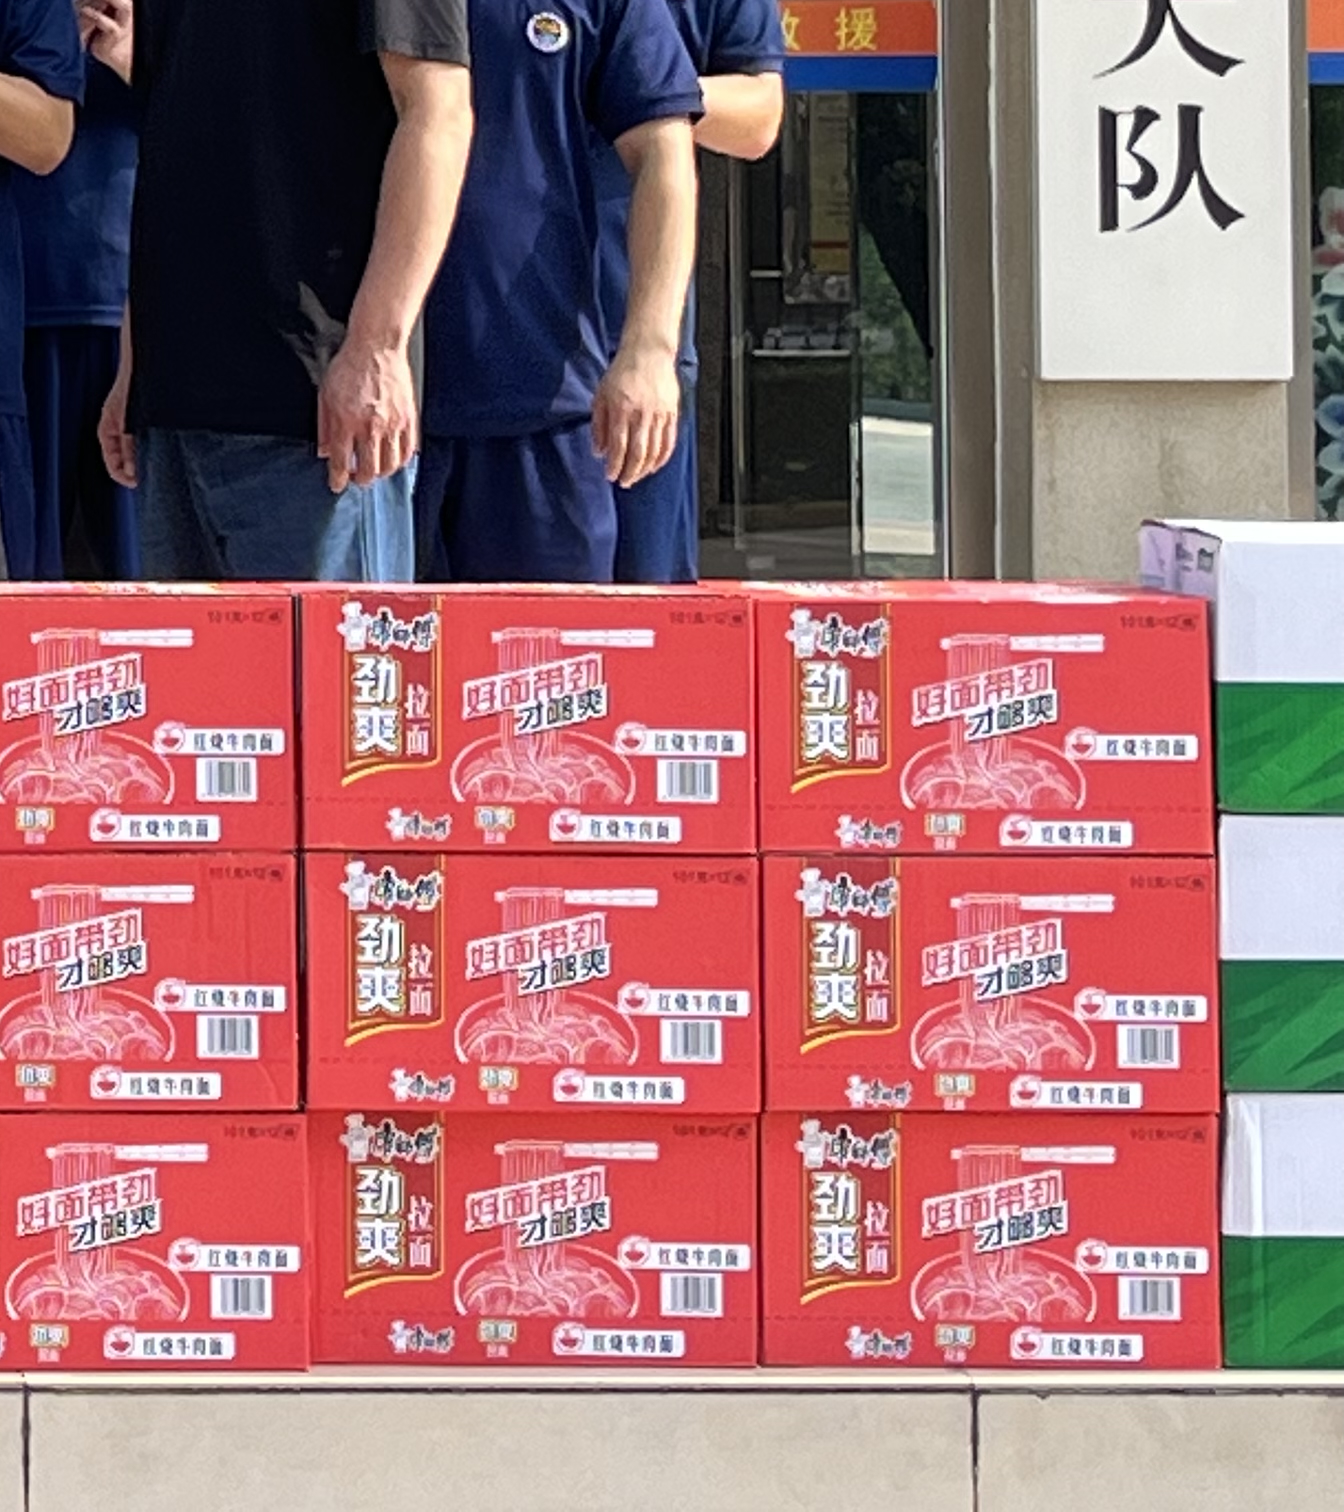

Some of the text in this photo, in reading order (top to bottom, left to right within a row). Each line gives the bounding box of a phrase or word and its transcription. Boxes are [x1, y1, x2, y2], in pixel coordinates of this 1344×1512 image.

[5, 659, 141, 718] 好面带劲
[353, 656, 401, 755] 劲爽
[405, 684, 430, 757] 拉面
[465, 659, 601, 718] 好面带劲
[803, 662, 851, 761] 劲爽
[916, 664, 1052, 723] 好面带劲
[855, 690, 880, 763] 拉面
[6, 915, 142, 974] 好面带劲
[356, 916, 404, 1015] 劲爽
[408, 944, 433, 1017] 拉面
[469, 918, 605, 977] 好面带劲
[812, 922, 860, 1021] 劲爽
[925, 924, 1061, 983] 好面带劲
[864, 950, 889, 1023] 拉面
[19, 1175, 155, 1234] 好面带劲
[356, 1167, 404, 1266] 劲爽
[408, 1195, 433, 1268] 拉面
[469, 1171, 605, 1230] 好面带劲
[812, 1173, 860, 1272] 劲爽
[926, 1176, 1062, 1235] 好面带劲
[864, 1201, 889, 1274] 拉面
